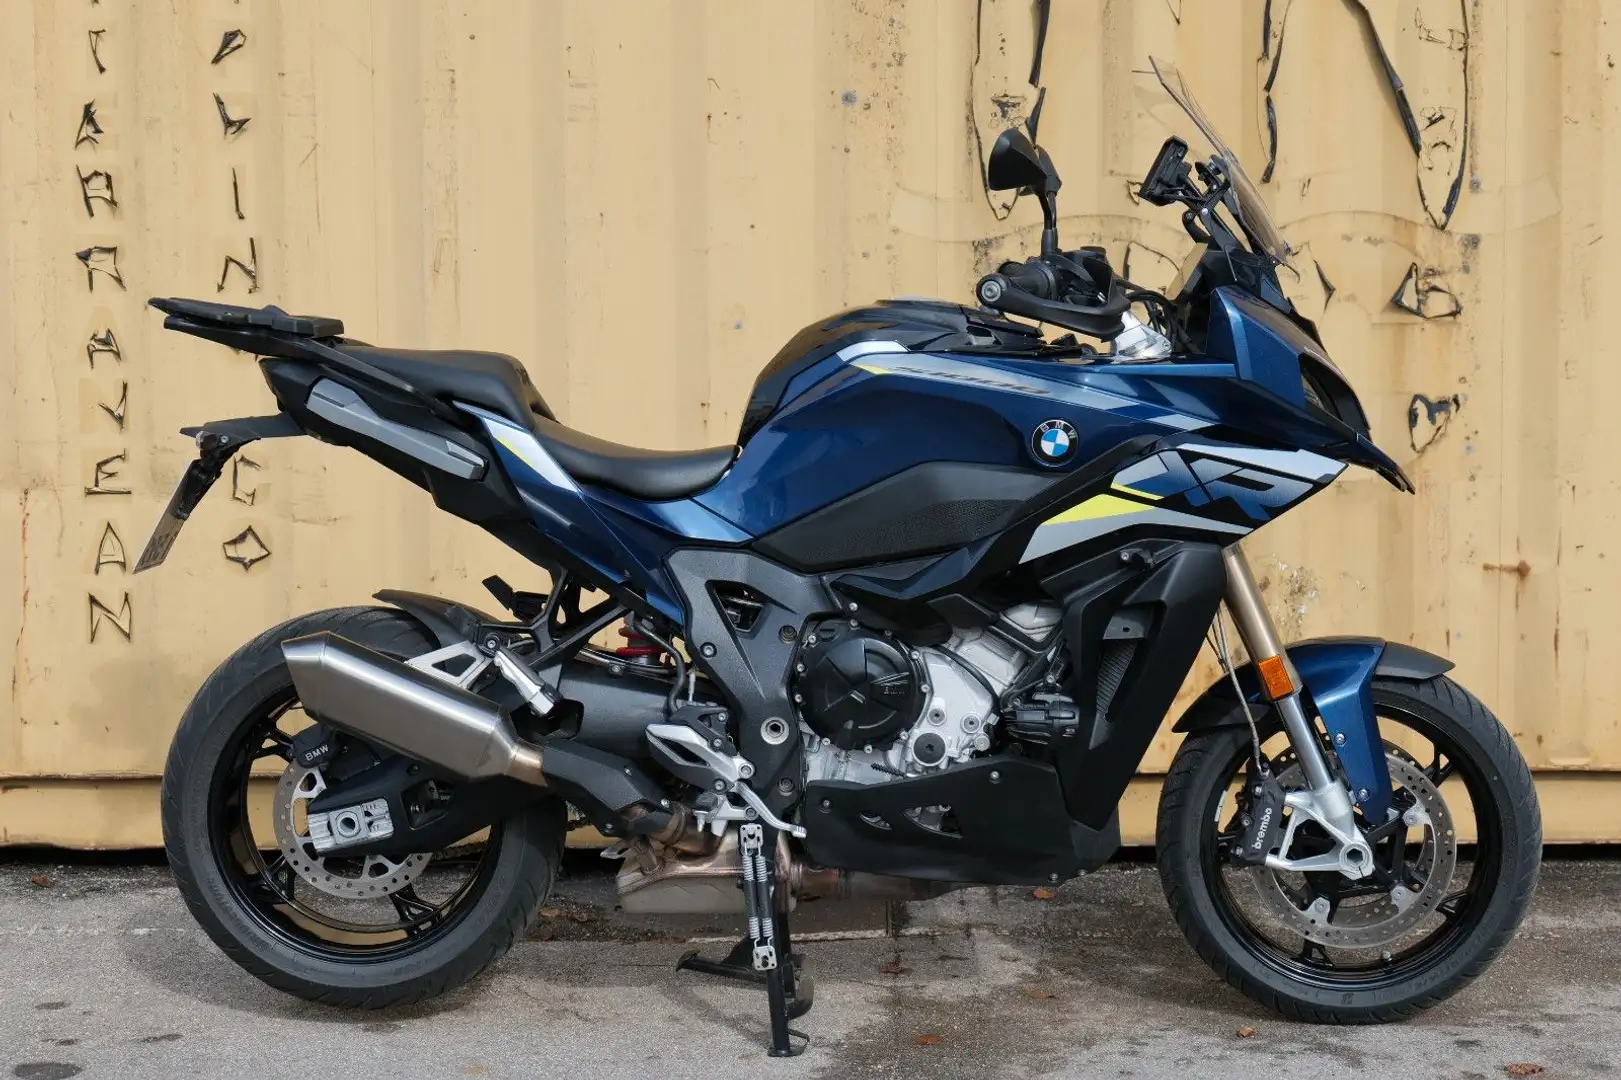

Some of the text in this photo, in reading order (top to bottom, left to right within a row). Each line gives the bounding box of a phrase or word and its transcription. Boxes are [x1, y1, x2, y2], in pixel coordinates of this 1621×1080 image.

[1040, 421, 1077, 439] BMW
[305, 744, 330, 762] BMW
[1252, 807, 1272, 849] brembo
